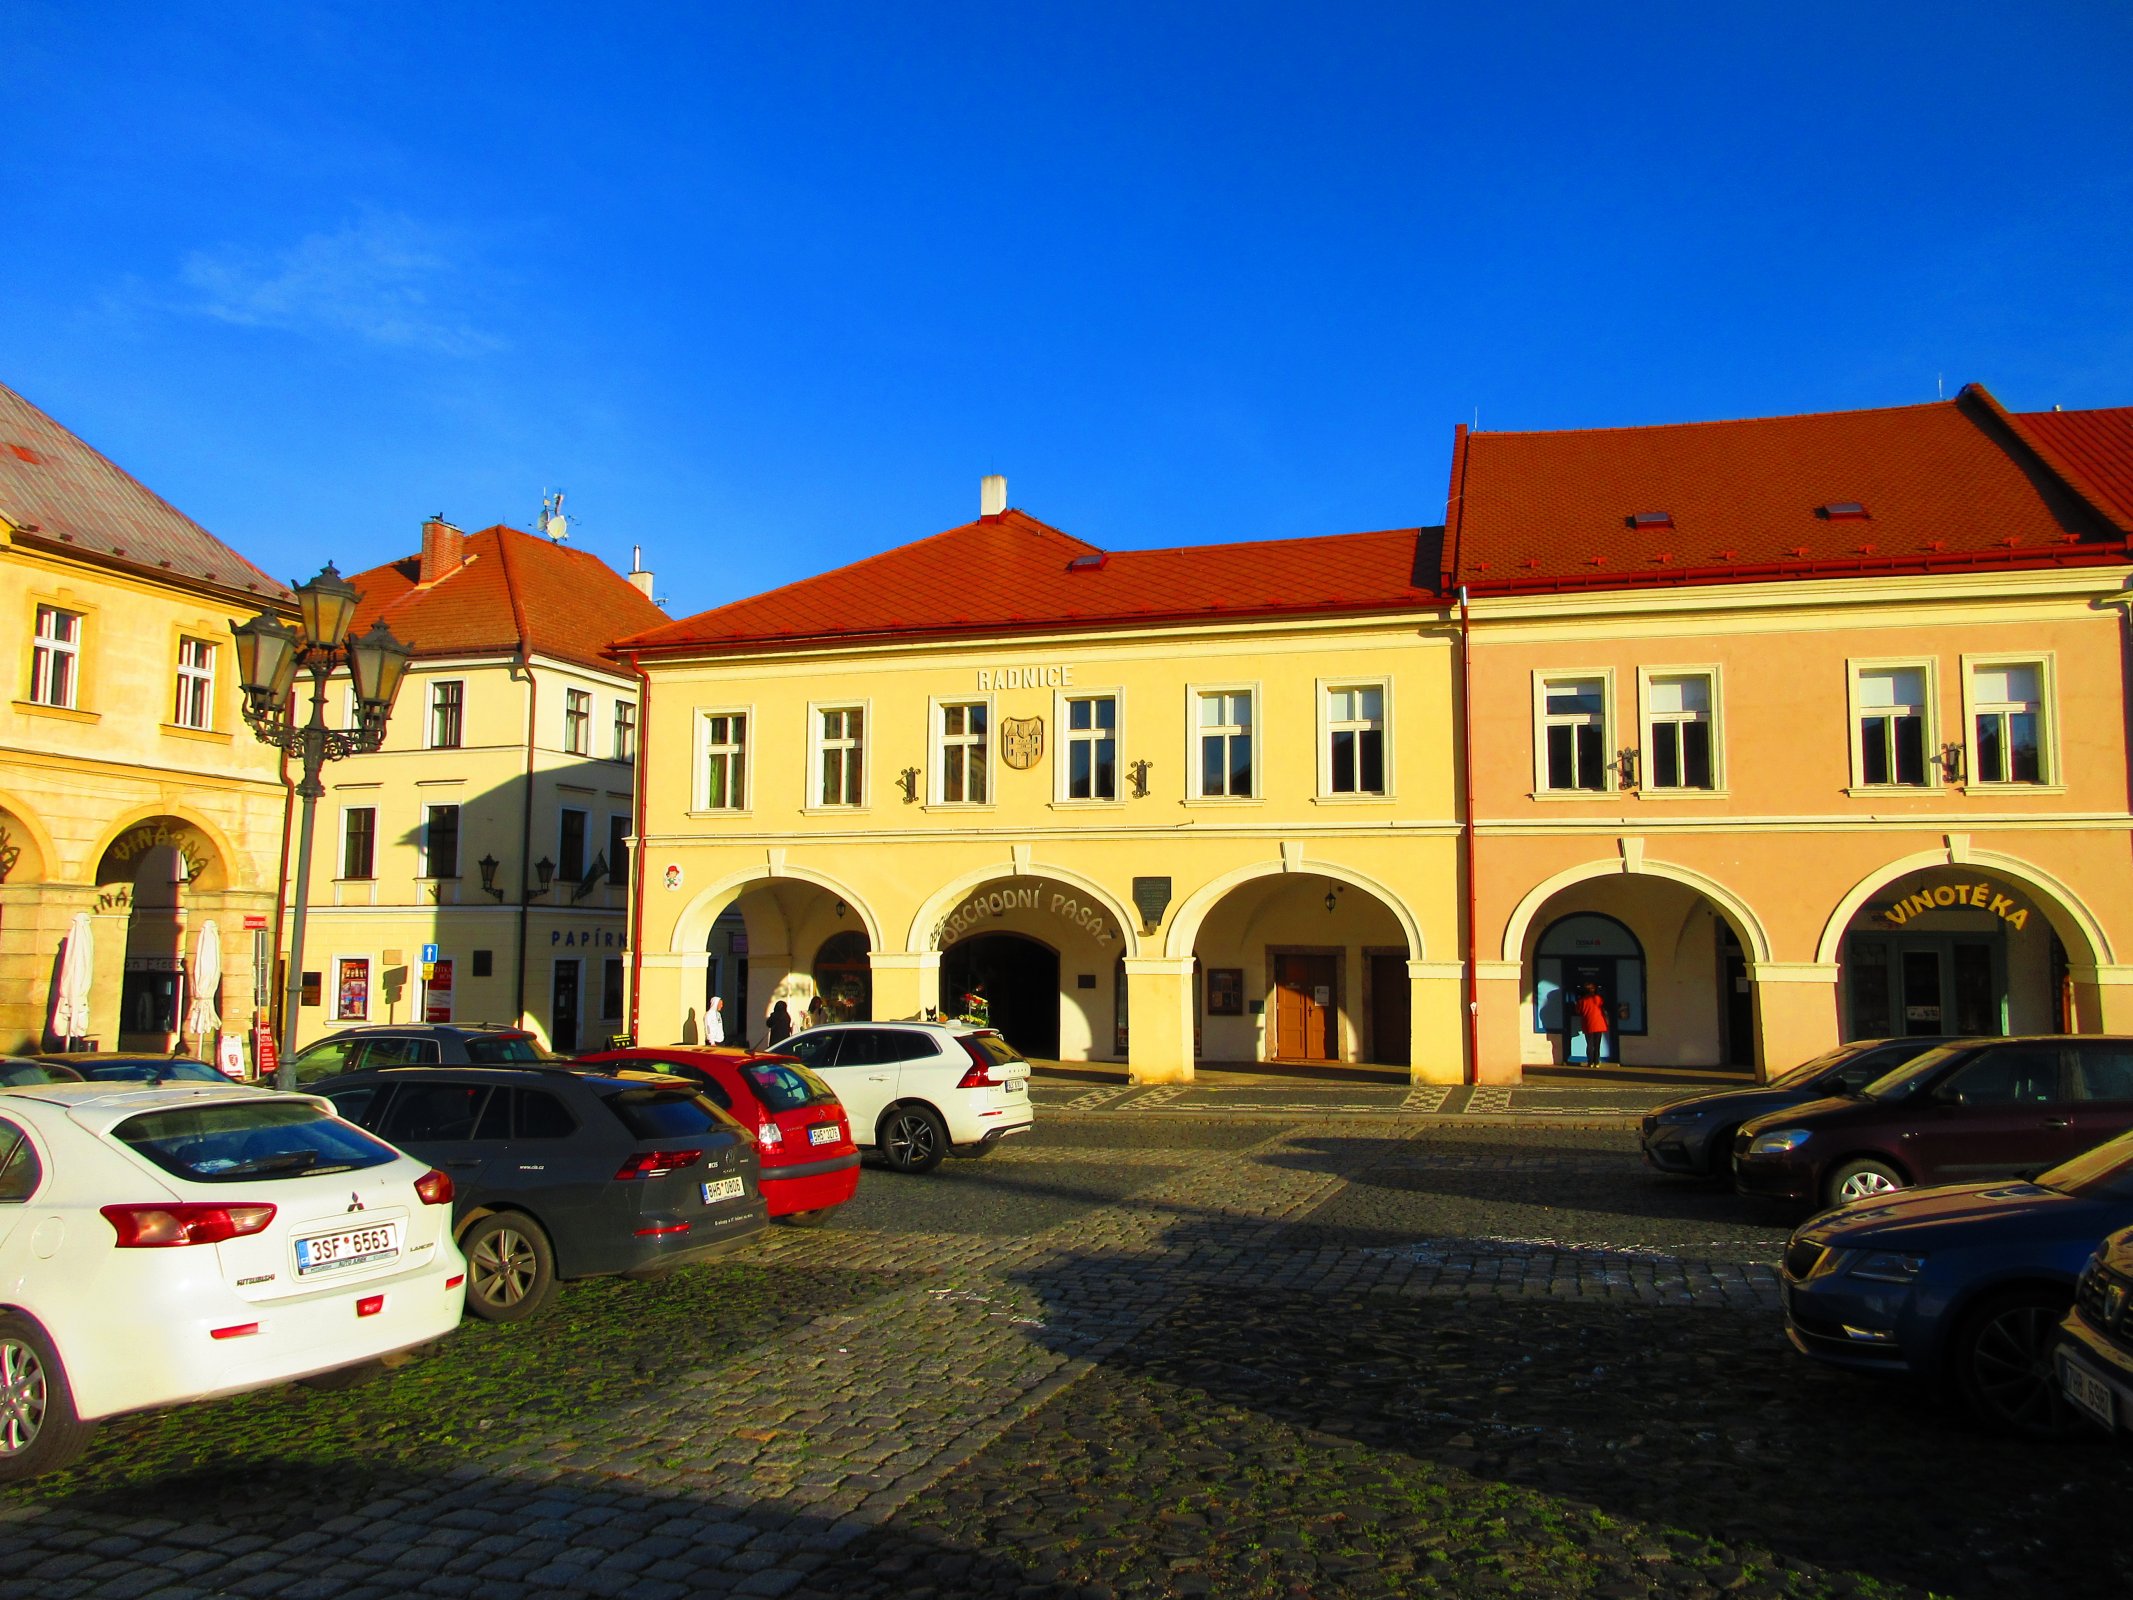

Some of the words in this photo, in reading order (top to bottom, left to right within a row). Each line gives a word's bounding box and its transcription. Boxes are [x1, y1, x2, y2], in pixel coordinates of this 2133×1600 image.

[977, 665, 1074, 691] RADNICE
[942, 883, 1043, 944] OBCHODNÍ
[1884, 883, 2028, 930] VINOTÉKA
[312, 1238, 341, 1261] 3SF
[352, 1229, 389, 1253] 6563
